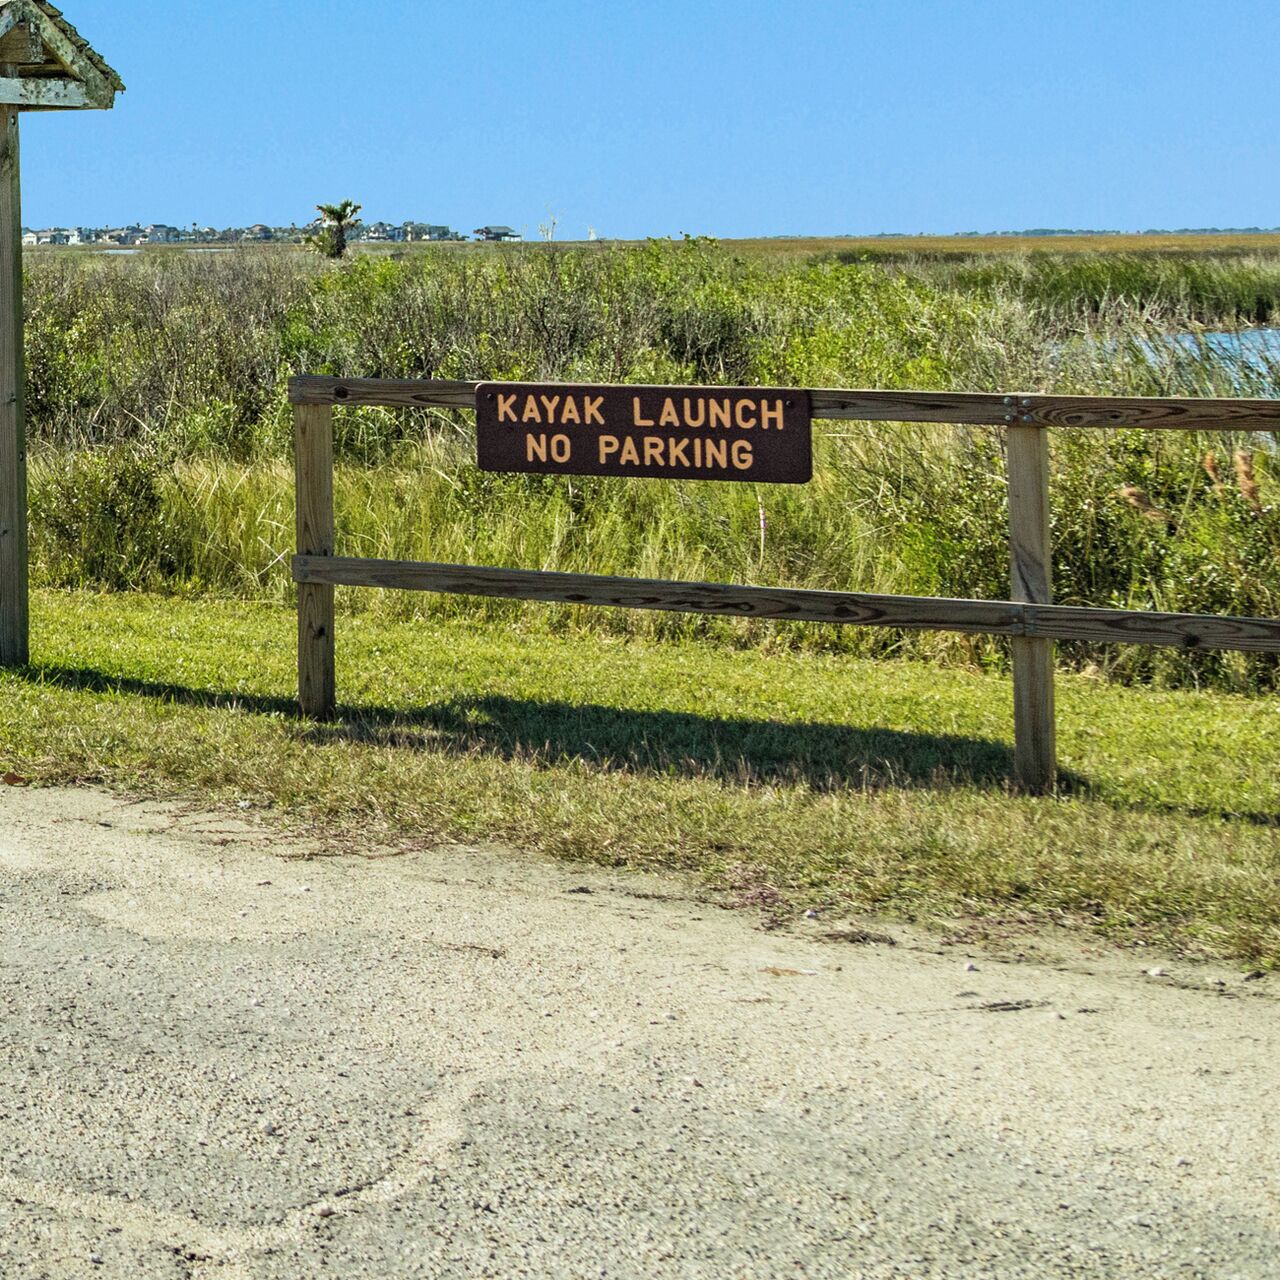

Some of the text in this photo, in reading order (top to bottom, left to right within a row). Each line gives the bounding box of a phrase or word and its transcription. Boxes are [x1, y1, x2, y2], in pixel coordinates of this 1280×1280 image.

[497, 394, 784, 430] KAYAK LAUNCH
[526, 433, 754, 470] NO PARKING
